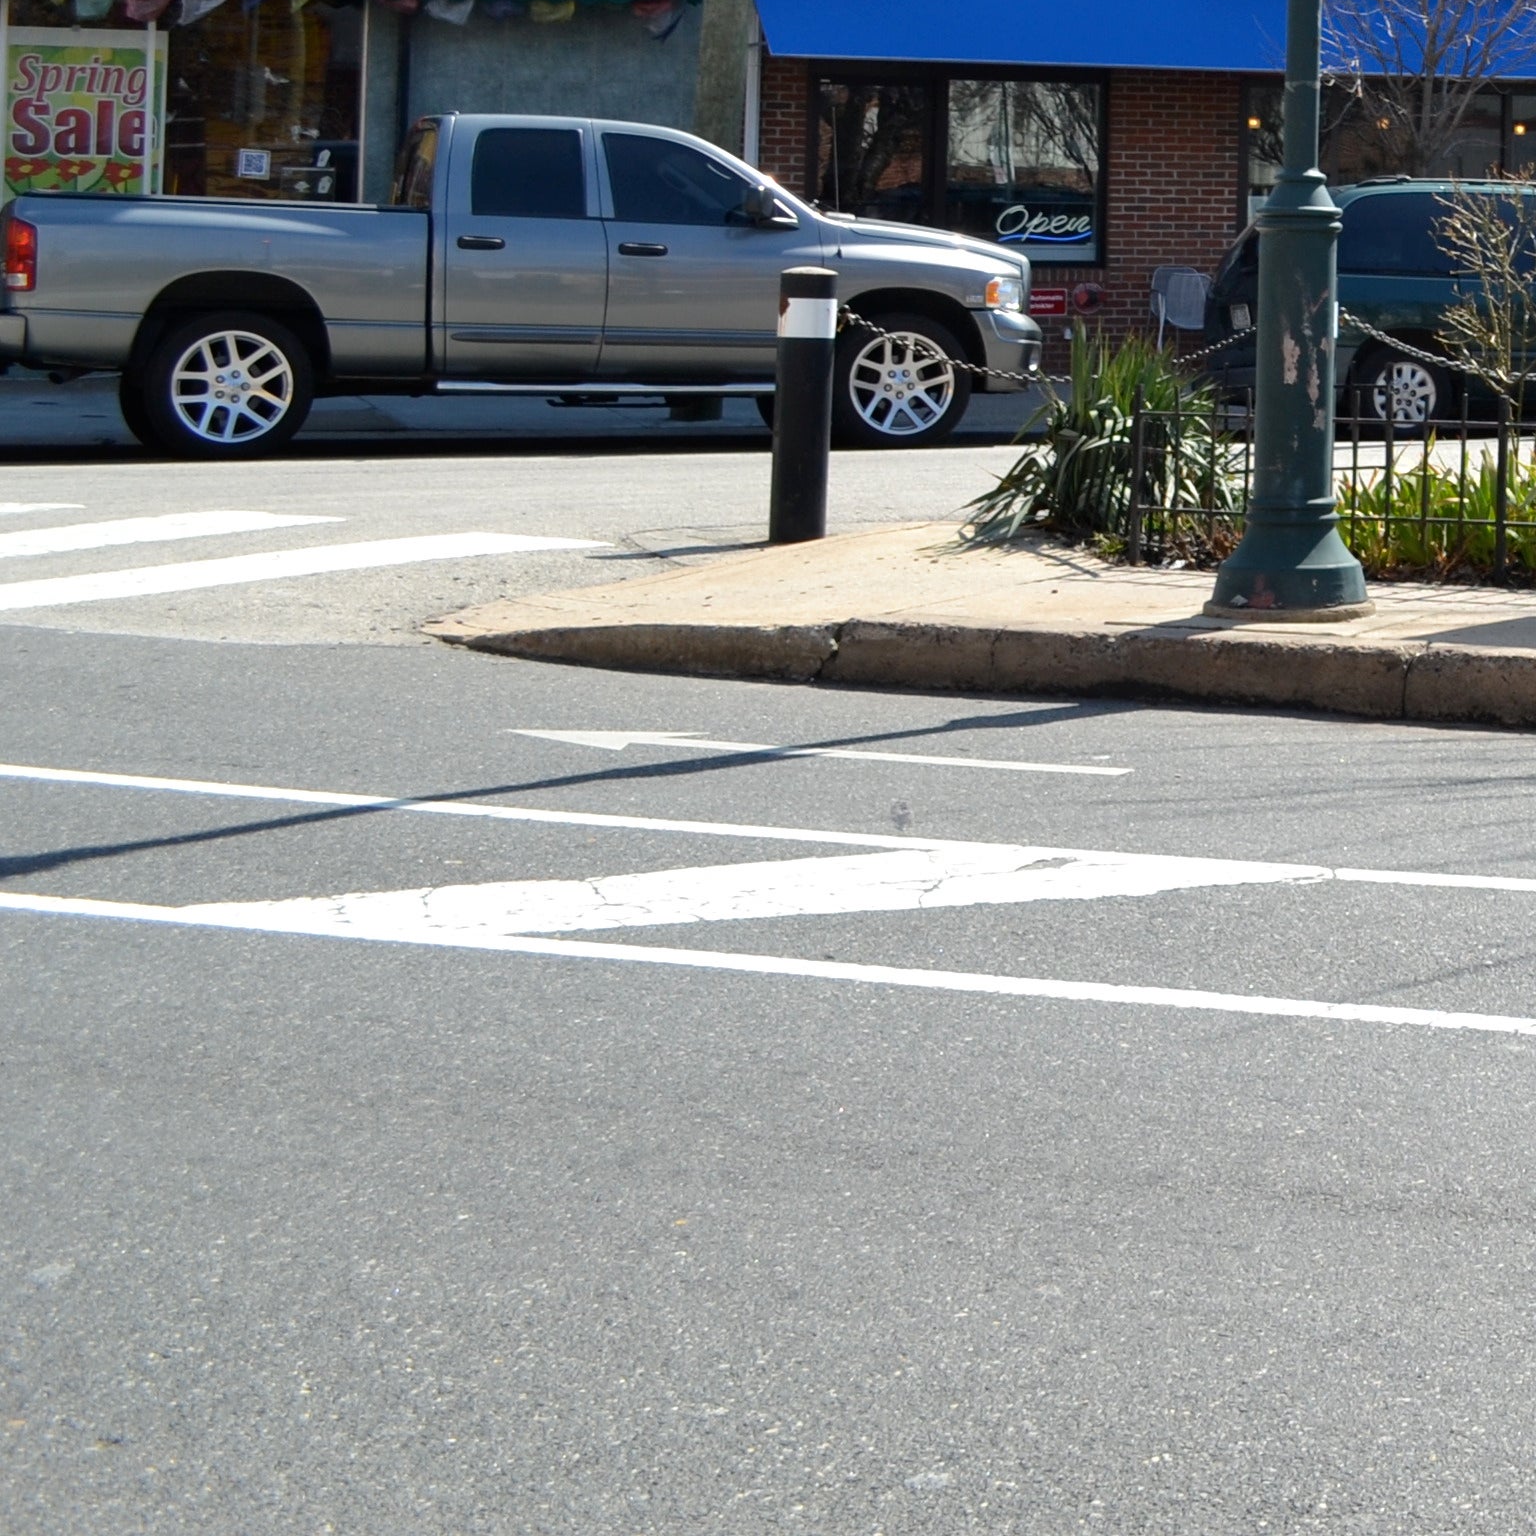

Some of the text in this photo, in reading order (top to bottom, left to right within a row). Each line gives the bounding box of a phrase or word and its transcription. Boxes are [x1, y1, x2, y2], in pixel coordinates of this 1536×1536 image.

[13, 54, 148, 105] Spring
[12, 98, 147, 157] Sale
[996, 205, 1091, 241] Open
